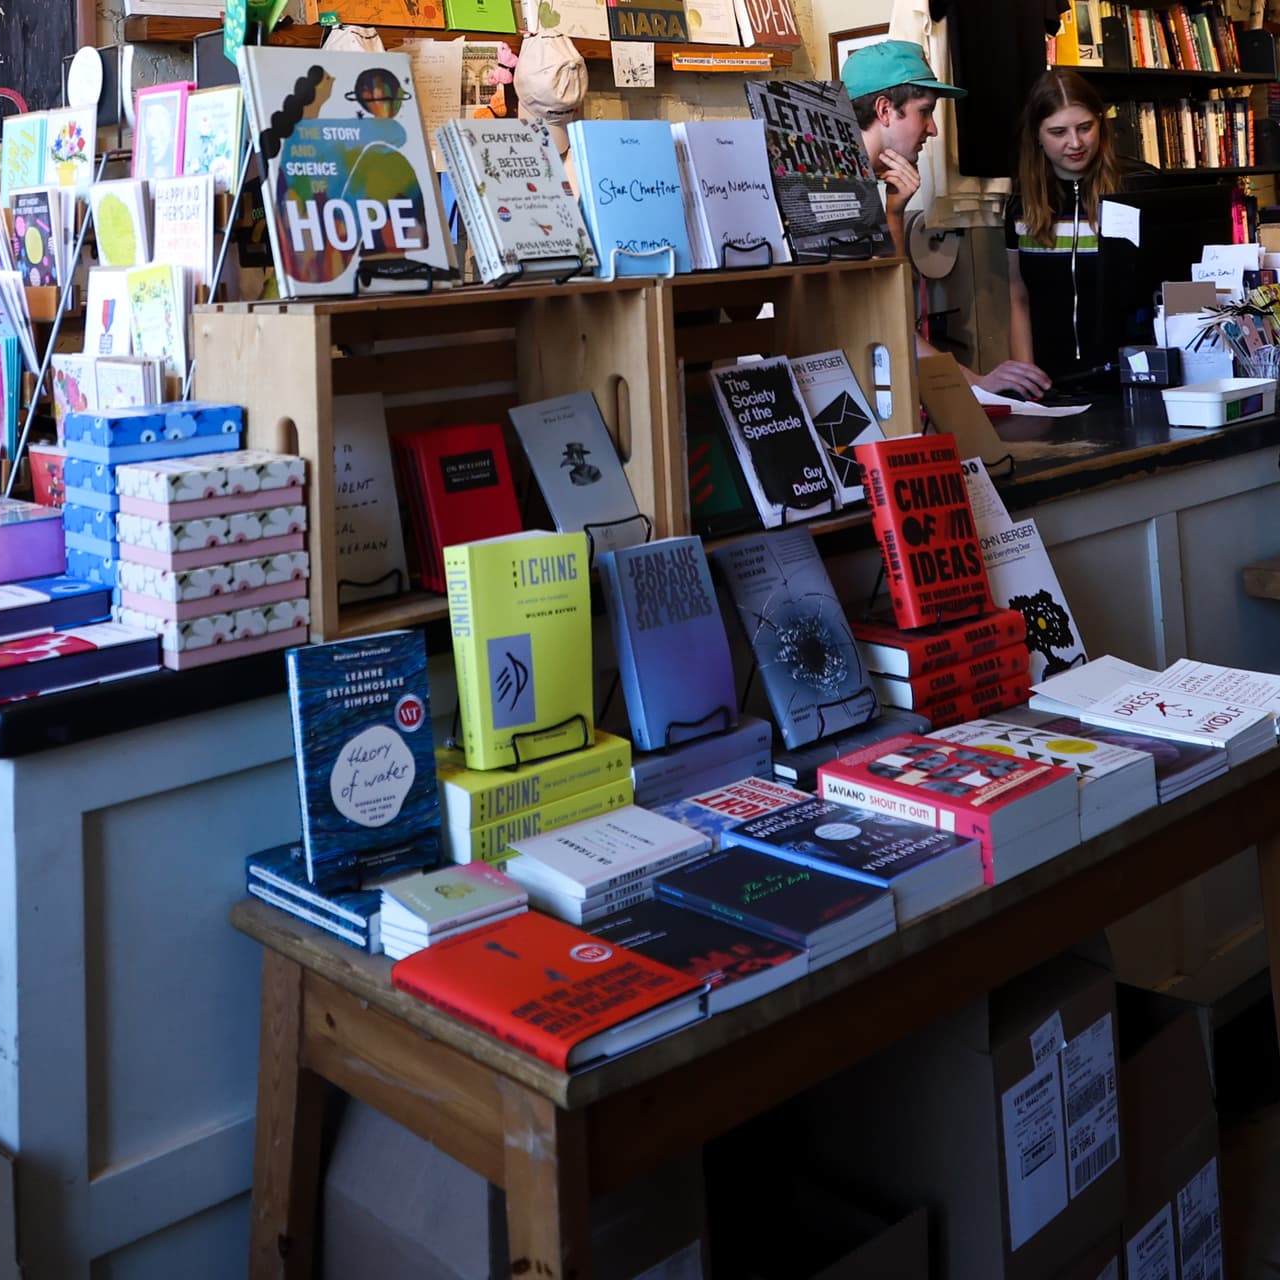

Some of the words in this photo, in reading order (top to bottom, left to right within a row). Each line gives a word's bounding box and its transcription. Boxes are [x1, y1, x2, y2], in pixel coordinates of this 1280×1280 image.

[619, 9, 687, 40] NARA
[759, 92, 803, 133] LET
[804, 108, 835, 140] ME
[298, 127, 321, 140] THE
[322, 126, 361, 141] STORY
[481, 132, 534, 145] CRAFTING
[836, 116, 856, 145] BE
[290, 145, 317, 158] AND
[496, 156, 540, 169] BETTER
[508, 147, 518, 155] A
[768, 131, 870, 179] HONEST
[285, 162, 338, 177] SCIENCE
[501, 167, 542, 179] WORLD
[598, 177, 628, 206] Star
[701, 179, 728, 200] Doing
[727, 180, 770, 201] Nothing
[284, 197, 422, 253] HOPE
[807, 355, 845, 373] BERGER
[723, 378, 751, 394] The
[731, 389, 776, 410] Society
[737, 409, 752, 424] of
[753, 406, 773, 420] the
[742, 415, 803, 441] Spectacle
[886, 452, 920, 469] IBRAM
[931, 448, 957, 464] KENDI
[803, 466, 823, 481] Guy
[792, 478, 829, 497] Debord
[893, 471, 968, 513] CHAIN
[871, 468, 887, 507] CHAIN
[883, 528, 903, 571] IBRAM
[1000, 523, 1036, 545] BERGER
[528, 553, 578, 586] CHING
[627, 545, 699, 578] JEAN-LUC
[908, 542, 983, 588] IDEAS
[631, 565, 700, 595] GODARD
[448, 578, 472, 639] CHING
[636, 609, 664, 632] SIX
[344, 668, 384, 683] LEANNE
[325, 676, 406, 700] BETASAMOSAKE
[343, 693, 390, 710] SIMPSON
[1113, 689, 1161, 718] DRESS
[1193, 705, 1246, 735] WOOLF
[346, 742, 392, 767] theory
[341, 769, 360, 803] of
[363, 761, 410, 789] water
[494, 775, 541, 816] CHING
[827, 782, 866, 803] SAVIANO
[868, 794, 898, 813] SHOUT
[898, 802, 907, 814] IT
[908, 805, 930, 821] OUT!
[743, 811, 781, 834] RIGHT
[804, 801, 843, 822] STORY
[862, 831, 949, 872] YUNKAPORTA
[869, 836, 914, 859] TYSON
